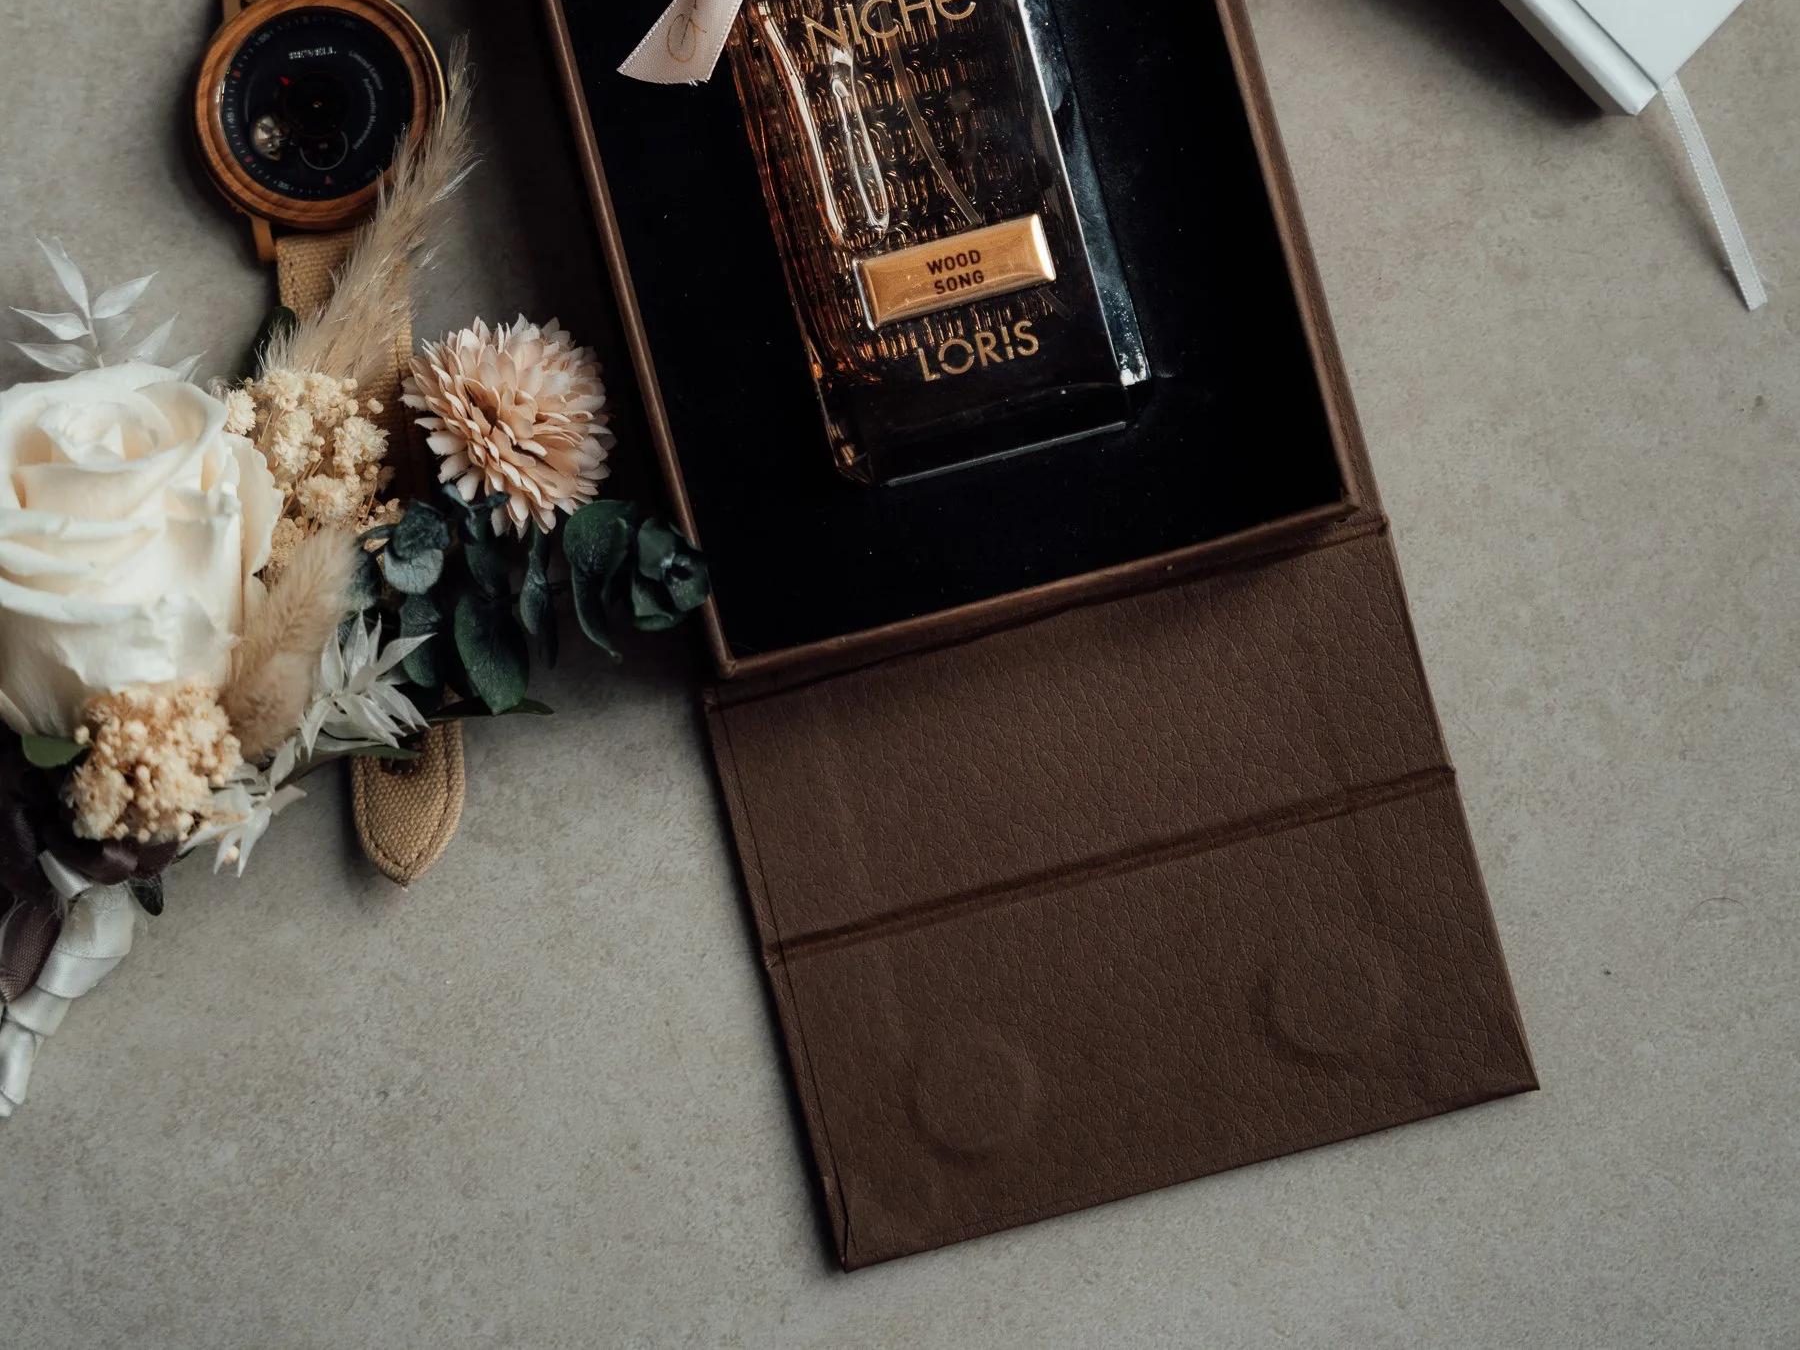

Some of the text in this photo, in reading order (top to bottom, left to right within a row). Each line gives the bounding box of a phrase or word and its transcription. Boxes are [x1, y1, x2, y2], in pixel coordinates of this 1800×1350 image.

[926, 249, 982, 276] WOOD
[934, 270, 985, 296] SONG
[917, 320, 1039, 382] LORIS
